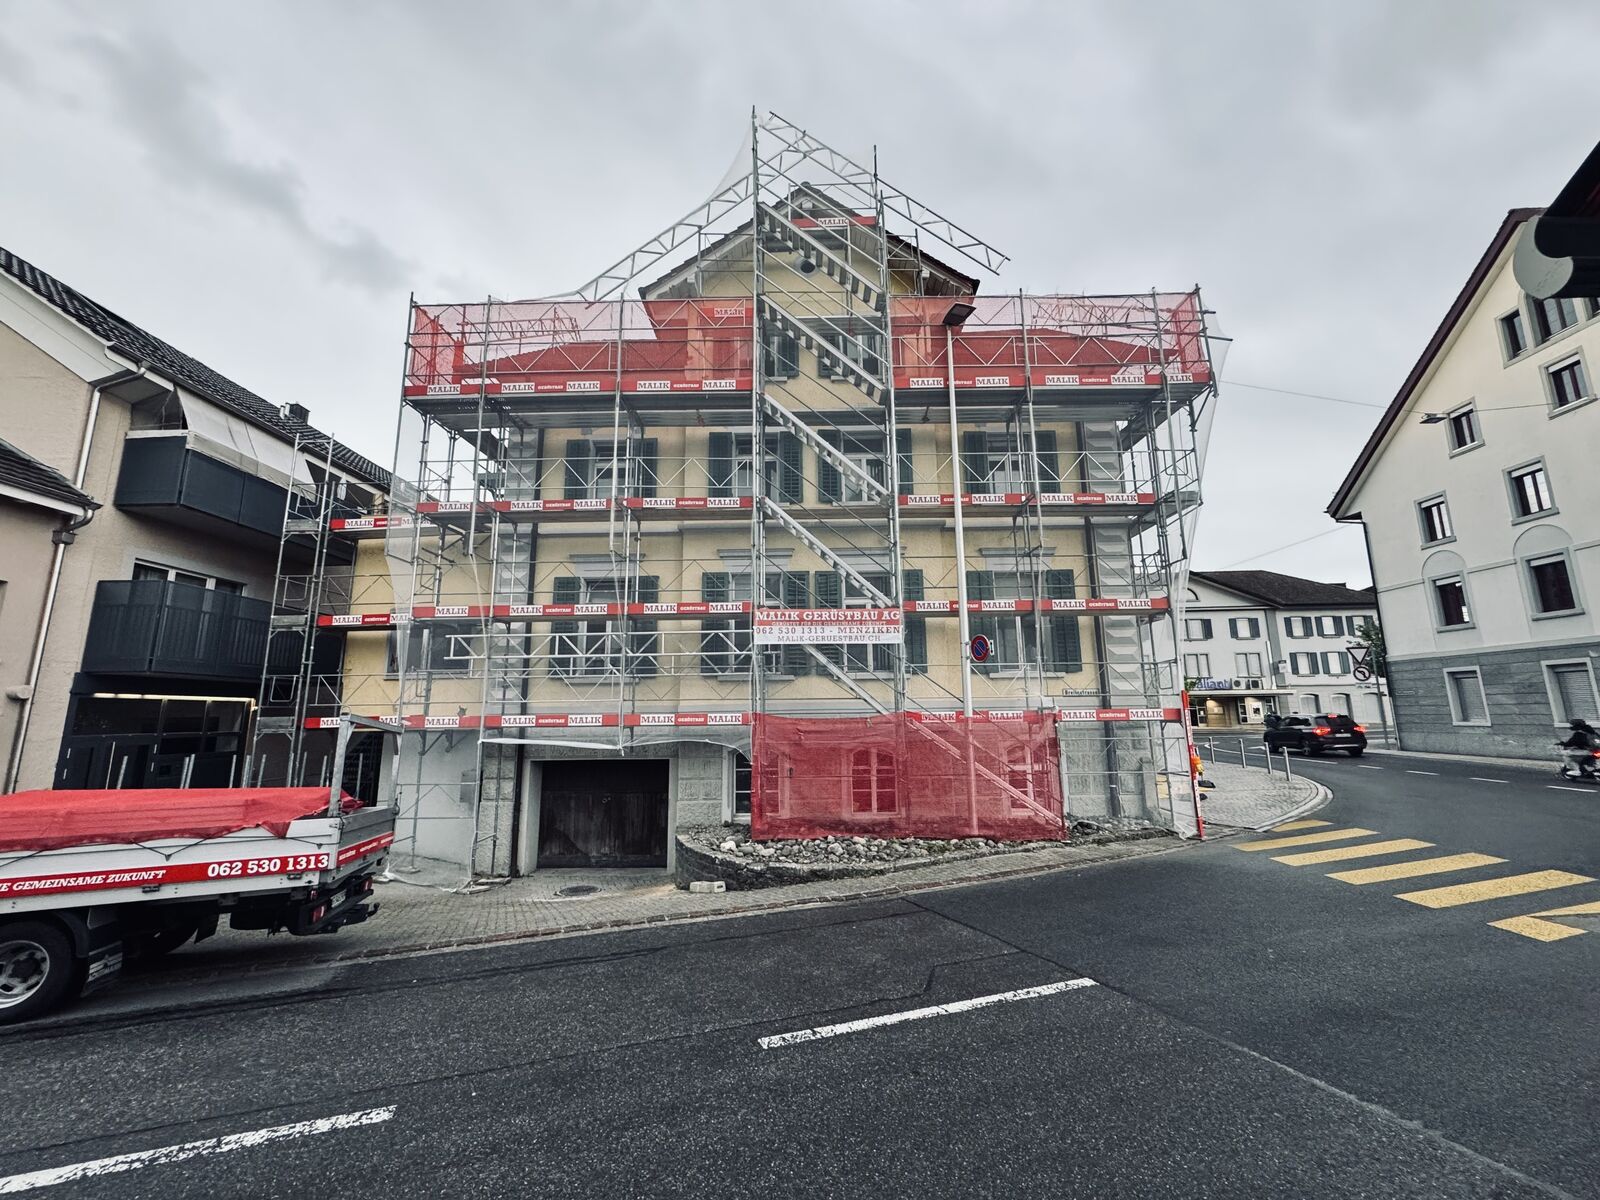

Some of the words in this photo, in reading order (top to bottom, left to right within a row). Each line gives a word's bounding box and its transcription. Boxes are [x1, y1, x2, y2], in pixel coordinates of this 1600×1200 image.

[714, 308, 744, 316] MALIK
[1111, 375, 1144, 383] MALIK
[567, 382, 599, 390] MALIK
[638, 382, 669, 390] MALIK
[708, 498, 740, 506] MALIK
[1041, 494, 1073, 502] MALIK
[1105, 494, 1138, 502] MALIK
[574, 500, 606, 508] MALIK
[644, 604, 677, 612] MALIK
[709, 603, 742, 611] MALIK
[982, 601, 1015, 609] MALIK
[436, 607, 468, 615] MALIK
[510, 606, 543, 614] MALIK
[575, 605, 607, 613] MALIK
[756, 611, 800, 620] MALIK
[803, 609, 878, 620] GERÜSTBAU
[882, 611, 900, 620] AG
[1196, 677, 1229, 689] aliant
[990, 712, 1023, 720] MALIK
[1062, 711, 1095, 719] MALIK
[1130, 710, 1163, 718] MALIK
[426, 718, 459, 726] MALIK
[502, 717, 535, 725] MALIK
[569, 716, 602, 724] MALIK
[709, 715, 742, 723] MALIK
[208, 862, 243, 877] 062
[247, 859, 281, 873] 530
[286, 855, 329, 871] 1313
[13, 876, 106, 890] GEMEINSAME
[106, 870, 166, 883] ZUKUNFT
